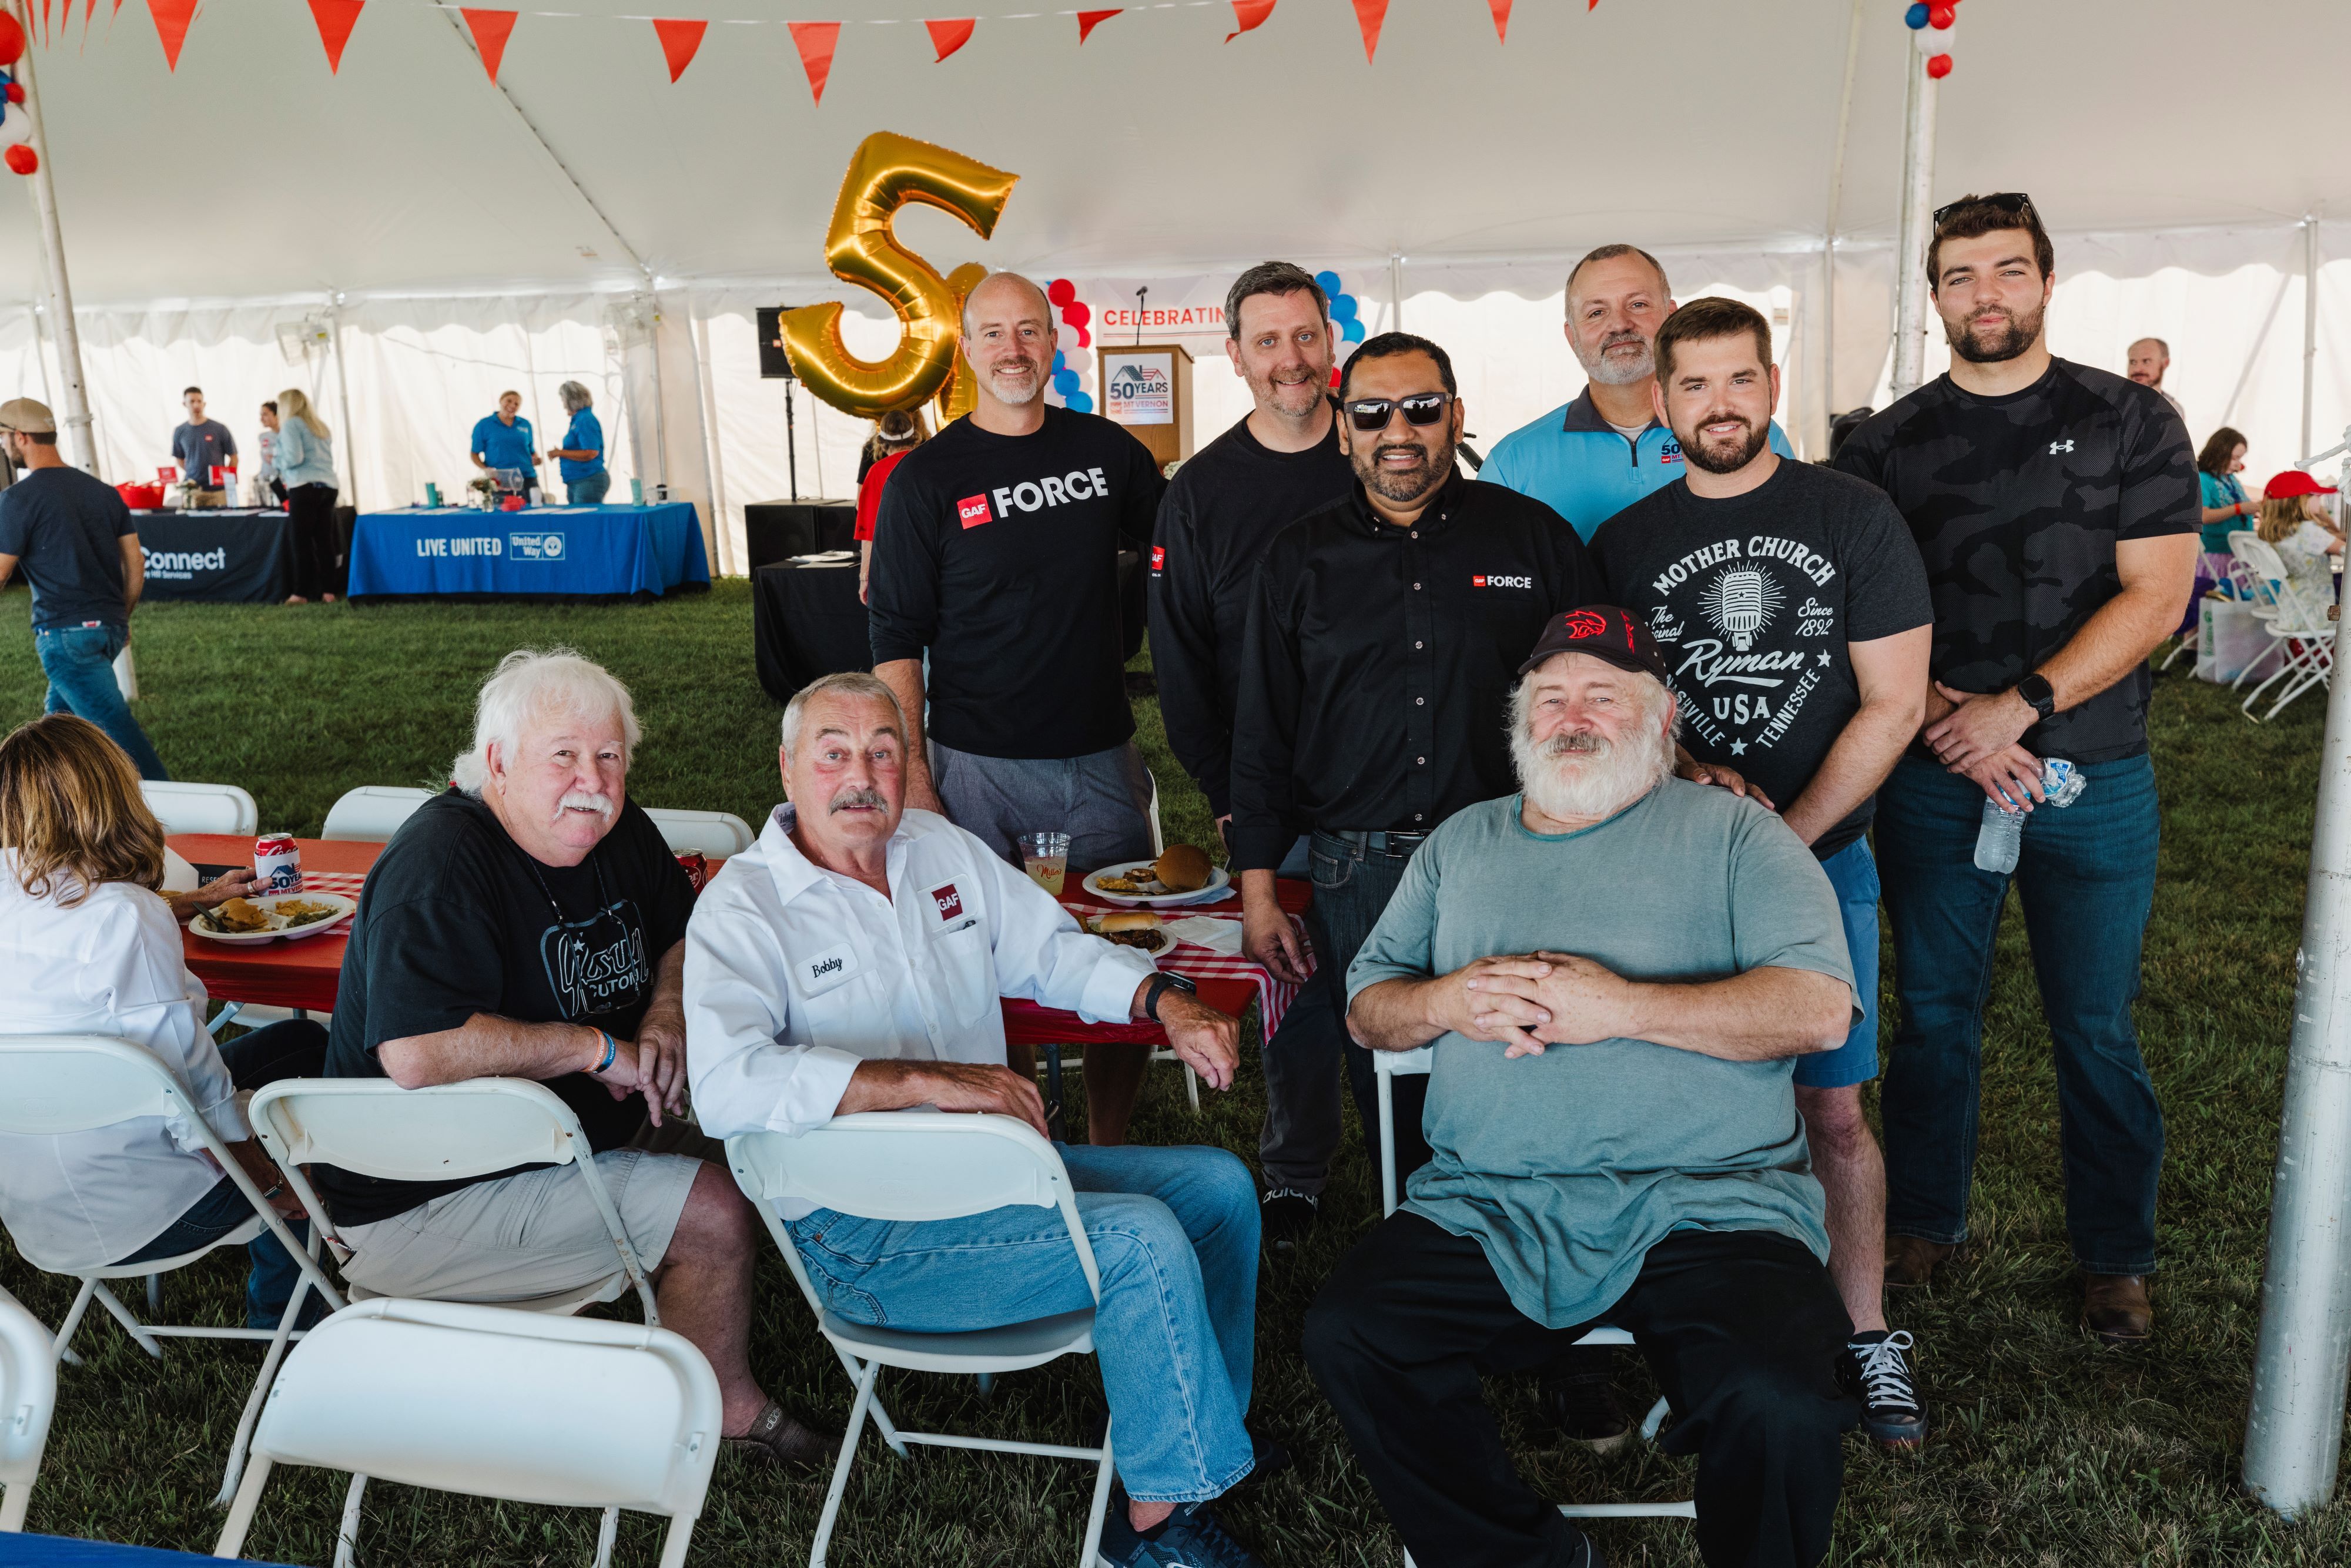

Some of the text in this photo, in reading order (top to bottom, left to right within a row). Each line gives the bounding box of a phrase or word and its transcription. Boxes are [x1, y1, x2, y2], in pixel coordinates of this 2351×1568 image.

[1110, 382, 1168, 400] 50 YEARS
[1661, 444, 1681, 455] 50
[961, 467, 1108, 518] GAF FORCE
[417, 537, 502, 557] LIVE UNITED
[511, 536, 541, 547] United
[523, 546, 541, 558] Way
[1652, 535, 1836, 597] MOTHER CHURCH
[1487, 575, 1532, 589] FORCE
[1651, 605, 1674, 626] The
[1797, 597, 1834, 618] Since
[1794, 618, 1834, 637] 1892
[1675, 638, 1806, 688] Ryman
[1666, 674, 1726, 747] NSHVILLE
[1713, 693, 1771, 725] USA
[1755, 668, 1820, 749] TENNESSEE
[1036, 864, 1063, 879] Miller's
[269, 876, 290, 889] 50
[937, 893, 959, 912] GAF
[812, 957, 843, 978] Bobby
